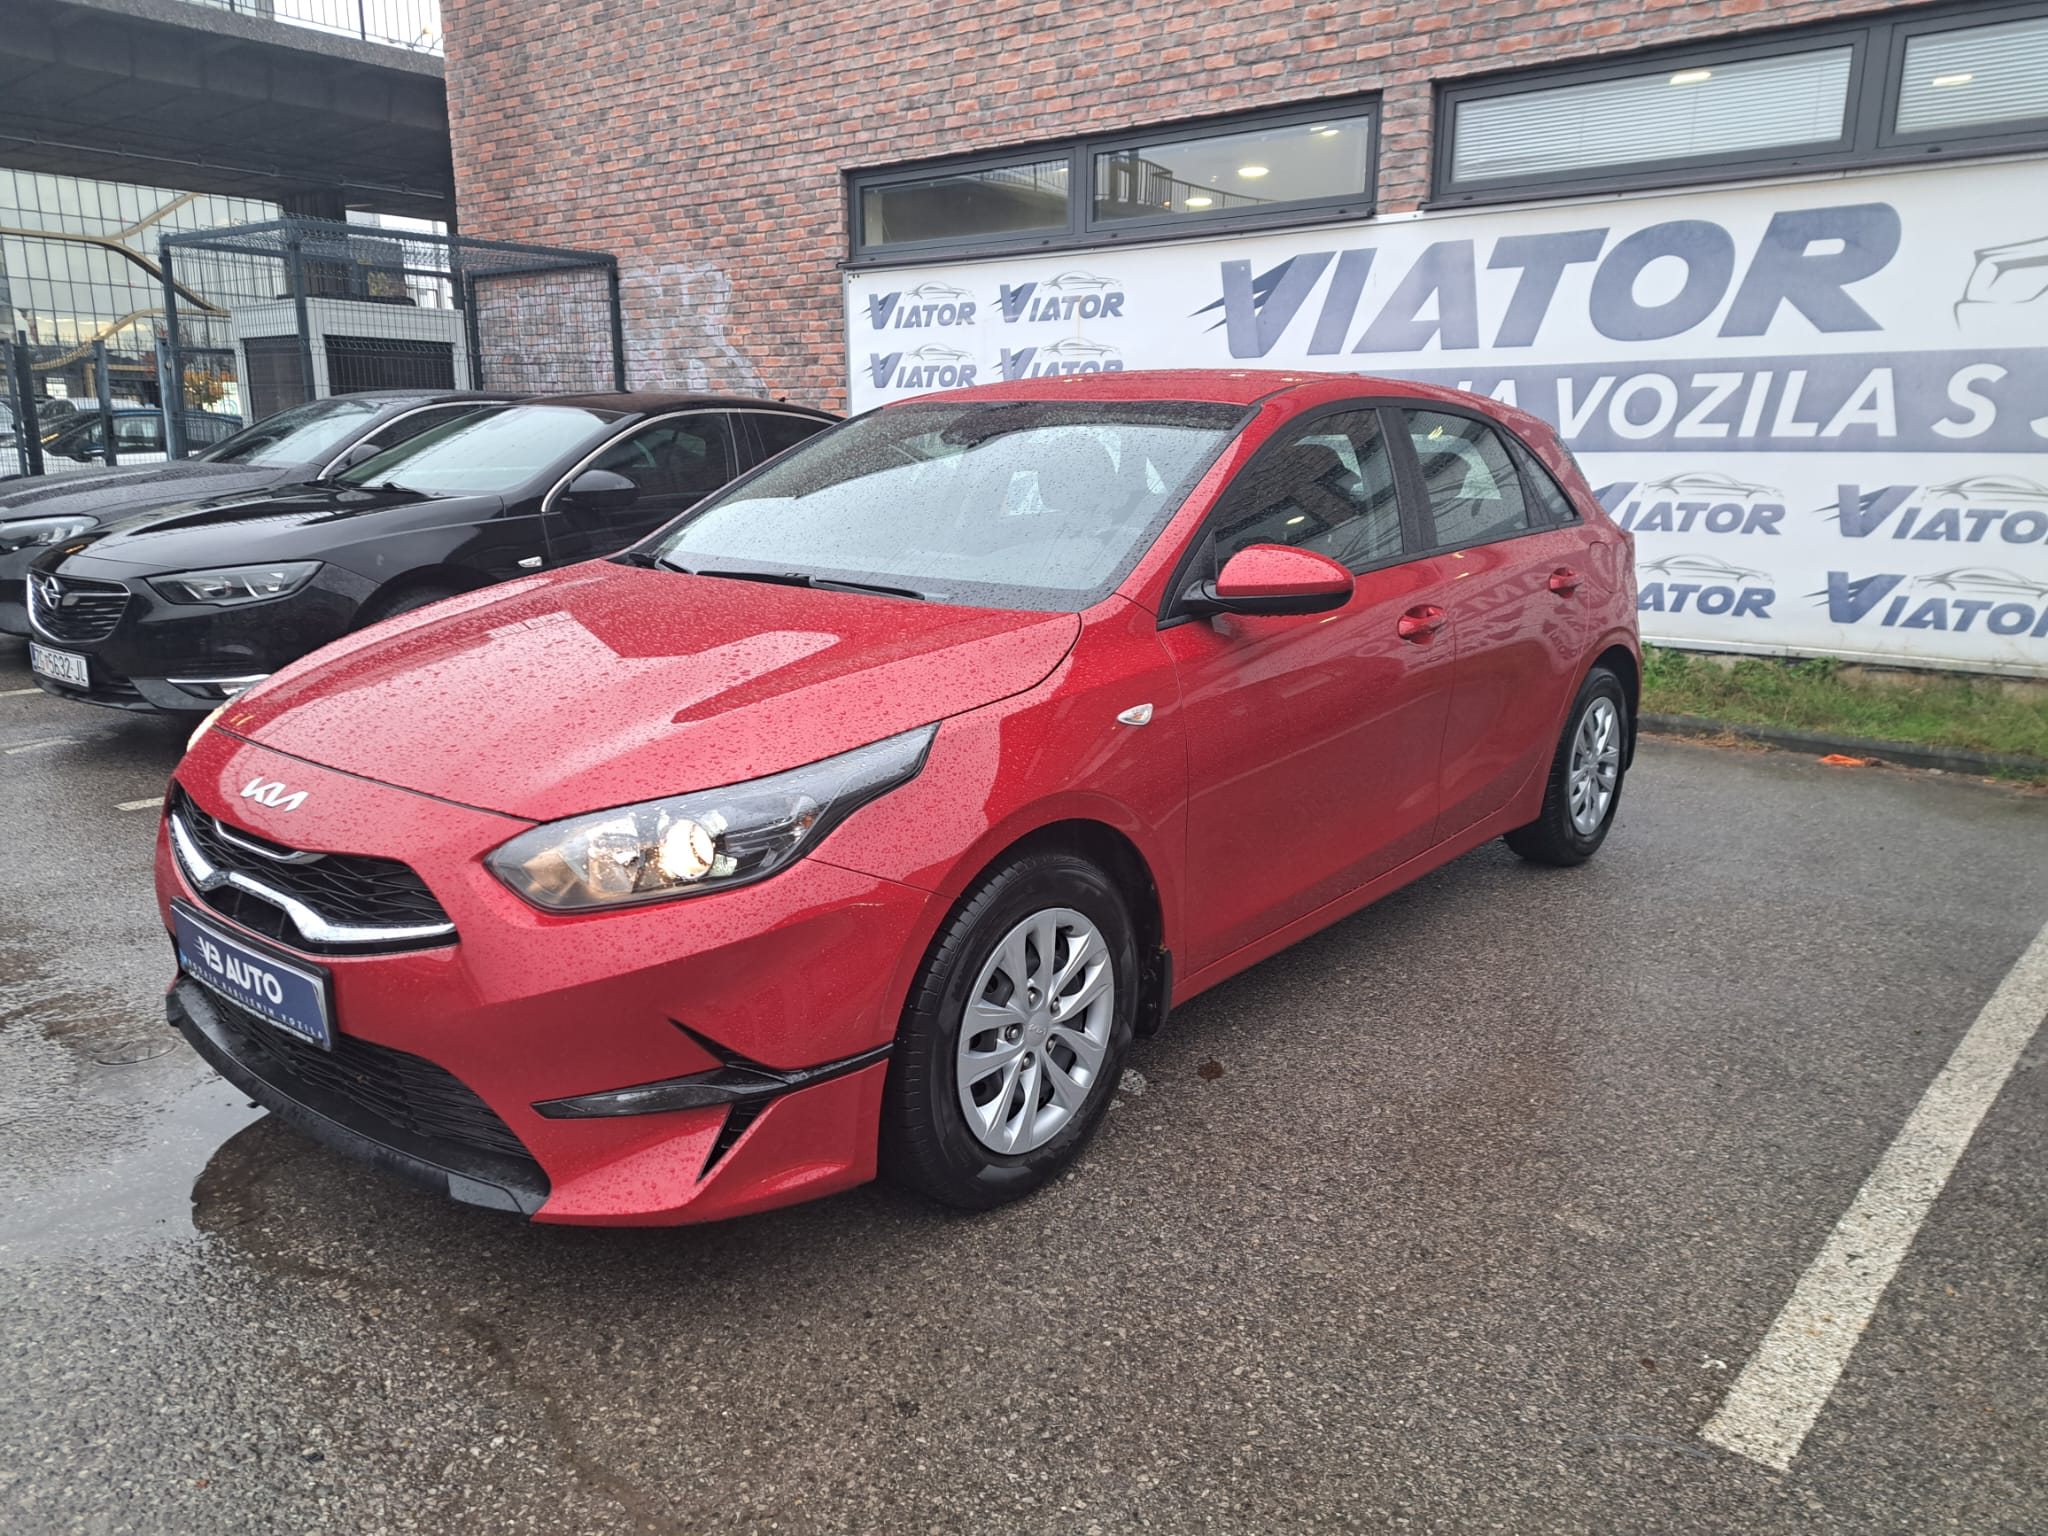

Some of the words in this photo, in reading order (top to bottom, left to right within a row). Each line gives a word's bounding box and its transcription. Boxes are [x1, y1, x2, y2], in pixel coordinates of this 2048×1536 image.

[1000, 282, 1125, 323] VIATOR
[1220, 201, 1902, 359] VIATOR
[868, 291, 976, 330] VIATOR
[870, 352, 977, 389] VIATOR
[1556, 367, 1898, 440] VOZILA
[1930, 363, 2009, 439] S
[1837, 484, 2048, 545] VIATO
[1637, 582, 1777, 619] ATOR
[226, 953, 283, 1005] AUTO
